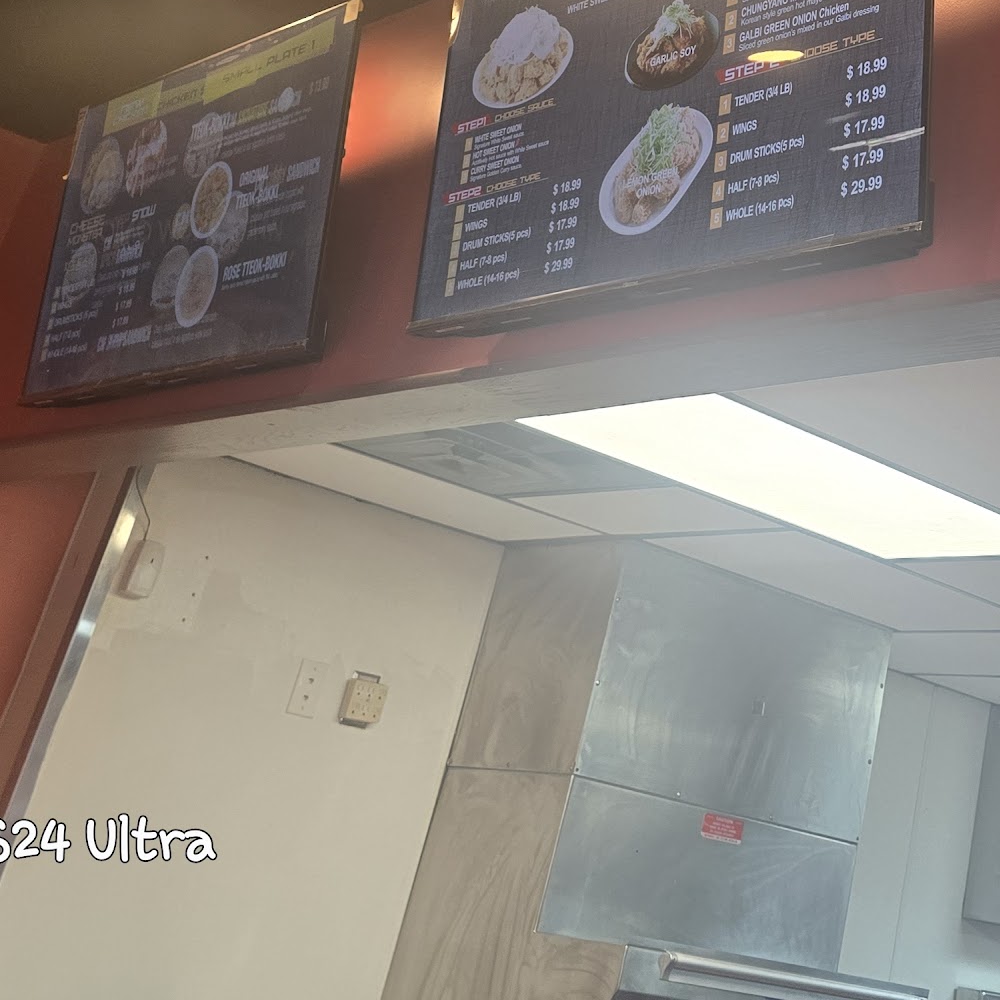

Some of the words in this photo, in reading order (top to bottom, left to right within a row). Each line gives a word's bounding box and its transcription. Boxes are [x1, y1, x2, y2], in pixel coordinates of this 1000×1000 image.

[567, 0, 588, 14] WHITE
[777, 5, 794, 16] green
[795, 1, 805, 10] hot
[740, 27, 762, 42] GALBI
[764, 18, 790, 35] GREEN
[792, 10, 818, 27] ONION
[819, 3, 849, 19] Chicken
[757, 36, 773, 47] green
[824, 18, 834, 27] our
[853, 4, 879, 18] dressing
[266, 44, 306, 67] PLATE
[649, 50, 678, 67] GARLIC
[679, 45, 697, 58] SOY
[725, 62, 764, 82] STEP
[843, 30, 876, 48] TYPE
[734, 91, 764, 107] TENDER
[780, 82, 793, 96] LB)
[495, 106, 525, 122] CHOOSE
[732, 120, 757, 136] WINGS
[730, 148, 752, 165] DRUM
[486, 178, 517, 193] CHOOSE
[520, 172, 541, 183] TYPE
[651, 167, 679, 182] GREEN
[728, 179, 748, 195] HALF
[764, 171, 780, 187] pcs)
[637, 183, 662, 198] ONION
[132, 204, 157, 222] SNOW
[467, 198, 495, 213] TENDER
[725, 205, 754, 221] WHOLE
[778, 195, 794, 211] pcs)
[69, 214, 106, 235] CHEESE
[465, 218, 488, 232] WINGS
[462, 238, 483, 251] DRUM
[223, 263, 242, 281] ROSE
[460, 258, 478, 271] HALF
[457, 276, 482, 290] WHOLE
